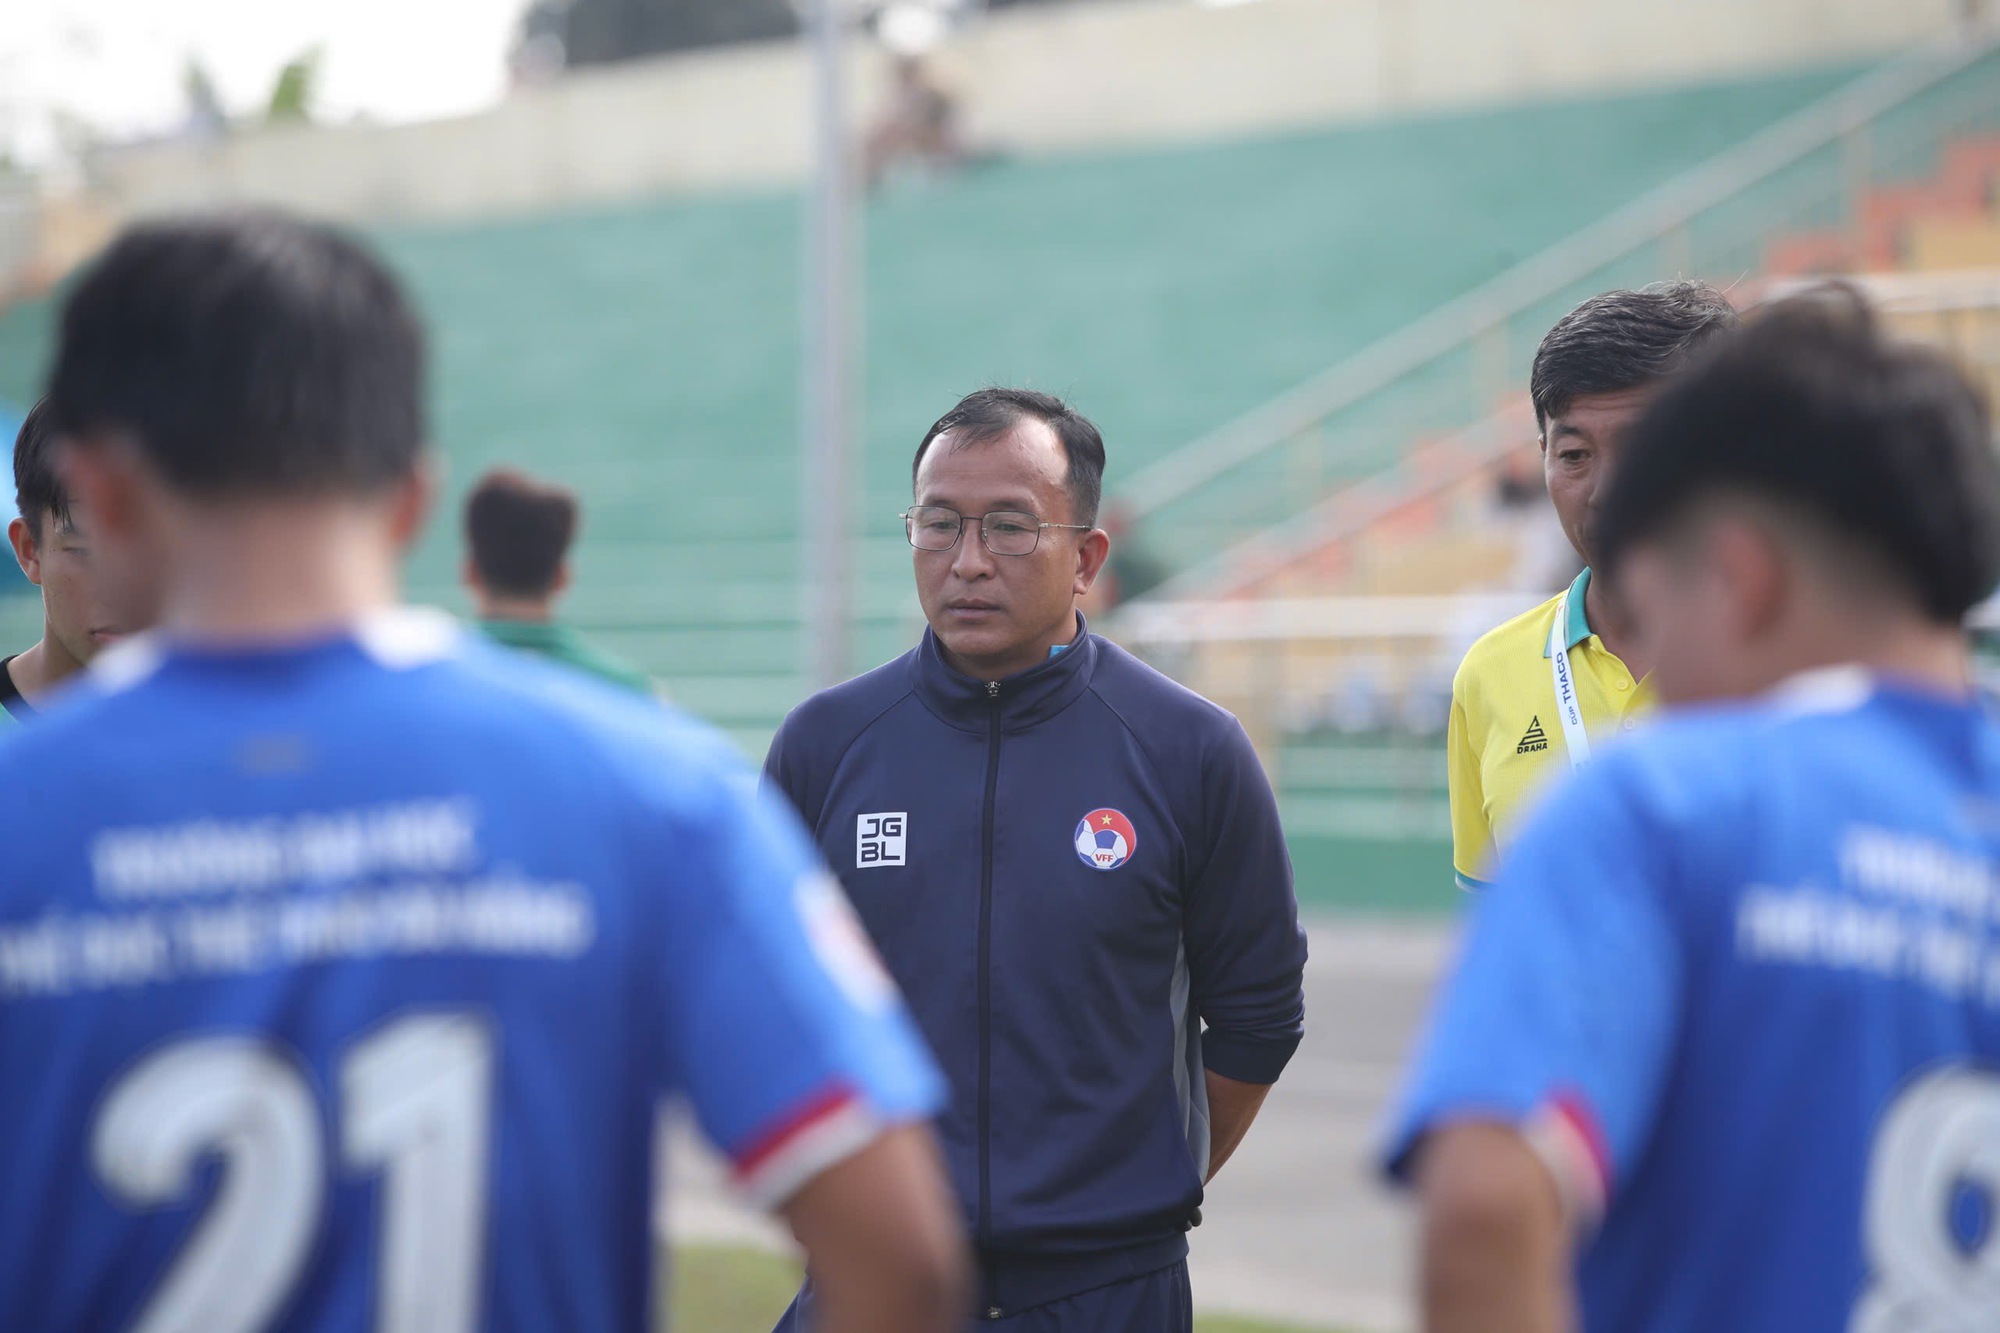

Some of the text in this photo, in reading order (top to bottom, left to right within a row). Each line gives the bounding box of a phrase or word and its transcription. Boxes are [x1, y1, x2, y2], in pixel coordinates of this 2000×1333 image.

[1556, 652, 1571, 704] THACO
[1517, 743, 1548, 754] DRAHA
[861, 817, 902, 839] JG
[861, 841, 901, 862] BL
[1095, 853, 1114, 862] VFF
[93, 1012, 492, 1333] 21
